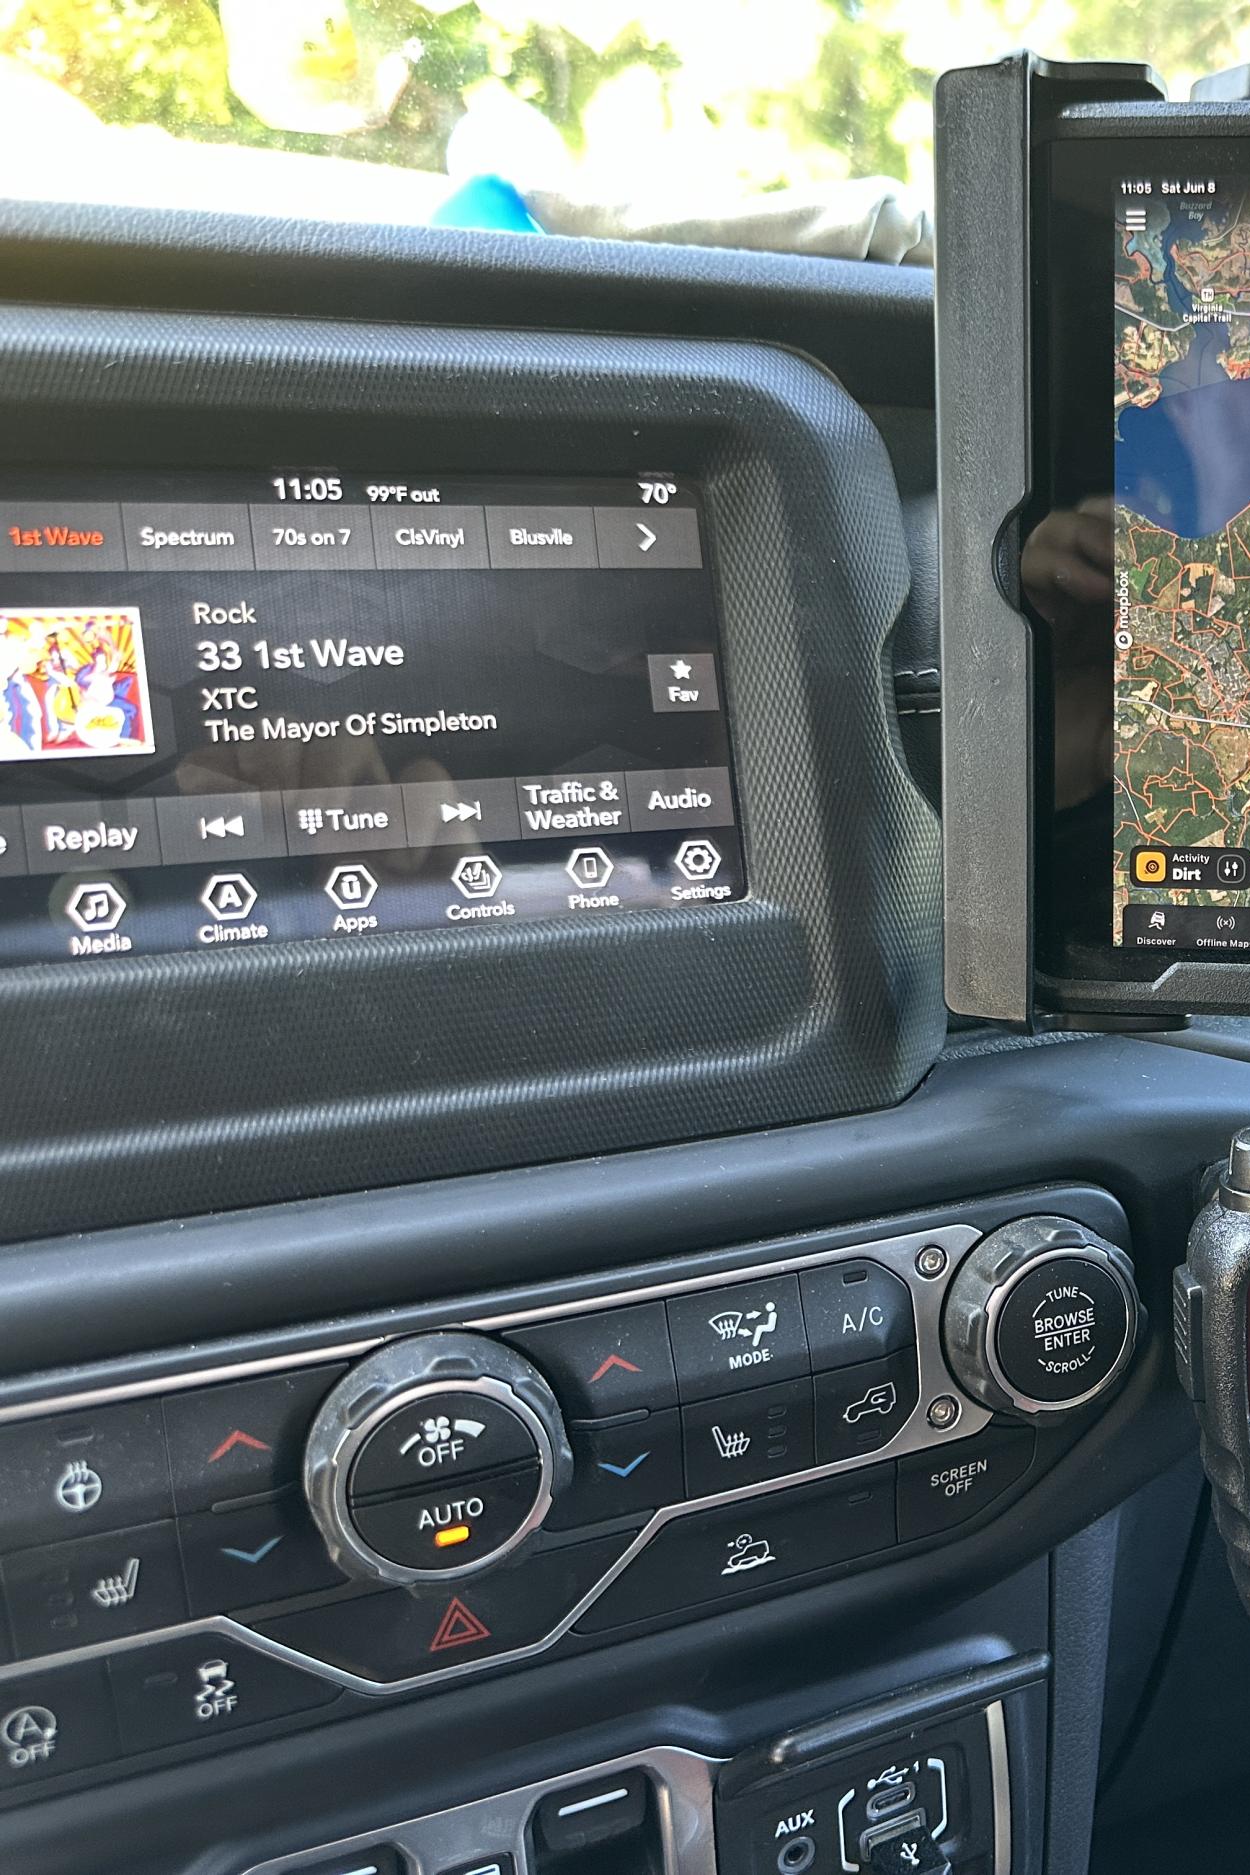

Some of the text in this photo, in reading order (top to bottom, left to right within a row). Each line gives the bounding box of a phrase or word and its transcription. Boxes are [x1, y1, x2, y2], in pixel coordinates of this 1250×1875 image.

[1120, 182, 1216, 194] 11:05 Sat Jun 8
[1188, 211, 1204, 221] Bay
[1191, 303, 1223, 313] Virginia
[1212, 313, 1232, 323] Trail
[272, 478, 344, 501] 11:05
[366, 485, 441, 503] 99°F out
[637, 482, 677, 504] 70°
[9, 526, 104, 546] 1st Wave
[139, 526, 235, 549] Spectrum
[272, 528, 351, 546] 70s on 7
[1119, 571, 1133, 630] mapbox
[193, 601, 257, 625] Rock
[197, 638, 405, 672] 33 1st Wave
[201, 686, 259, 711] XTC
[667, 686, 699, 703] Fav
[205, 709, 498, 743] The Mayor Of Simpleton
[523, 780, 620, 806] Traffic &
[647, 788, 712, 811] Audio
[325, 808, 389, 832] Tune
[524, 806, 623, 831] Weather
[46, 822, 138, 853] Replay
[1172, 853, 1210, 865] Activity
[1172, 867, 1202, 881] Dirt
[568, 894, 620, 910] Phone
[670, 883, 732, 902] Settings
[446, 900, 516, 921] Controls
[199, 922, 269, 944] Climate
[333, 913, 378, 934] Apps
[71, 932, 132, 956] Media
[1136, 936, 1176, 947] Discover
[1196, 938, 1227, 948] Offline
[1045, 1285, 1079, 1303] TUNE
[841, 1305, 885, 1334] A/C
[1034, 1307, 1095, 1334] BROWSE
[1044, 1328, 1091, 1351] ENTER
[728, 1348, 770, 1370] MODE
[1045, 1353, 1092, 1374] SCROLL
[418, 1439, 465, 1467] OFF
[930, 1458, 988, 1487] SCREEN
[944, 1477, 974, 1498] OFF
[418, 1496, 484, 1531] AUTO
[195, 1695, 239, 1721] OFF
[8, 1739, 57, 1768] OFF
[774, 1808, 816, 1840] AUX
